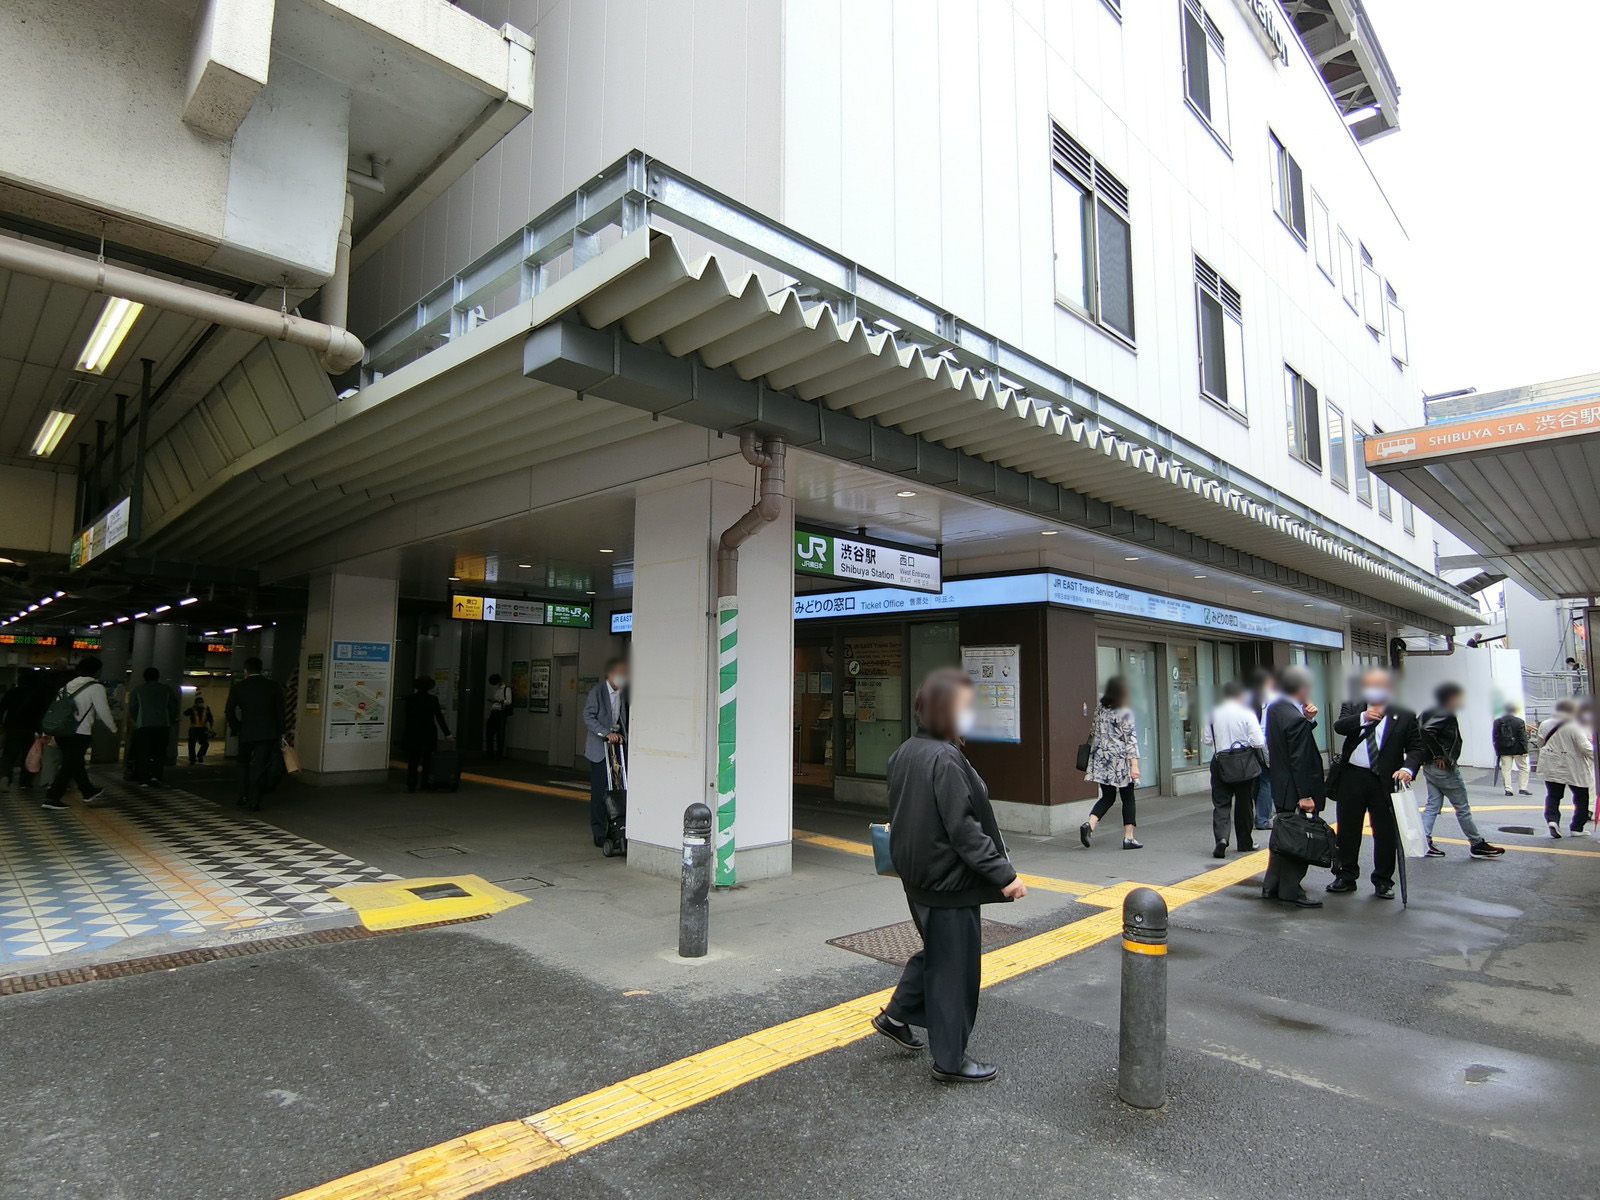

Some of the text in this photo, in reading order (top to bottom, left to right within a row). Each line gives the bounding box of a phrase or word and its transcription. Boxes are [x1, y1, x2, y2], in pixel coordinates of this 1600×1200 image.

[1428, 407, 1600, 446] SHIBUYA STA. 渋谷駅
[797, 536, 827, 562] JR
[840, 543, 877, 565] 渋谷駅
[899, 554, 915, 567] 西口
[840, 562, 895, 580] Shibuya Station
[899, 567, 931, 579] West Entrance
[1053, 578, 1062, 588] JR
[1062, 580, 1078, 592] EAST
[1079, 583, 1095, 594] Travel
[1096, 586, 1114, 598] Service
[1114, 590, 1130, 601] Center
[570, 607, 582, 616] JR
[794, 596, 856, 613] みどりの窓口
[861, 598, 905, 610] Ticket Office
[613, 615, 632, 623] JR EAST
